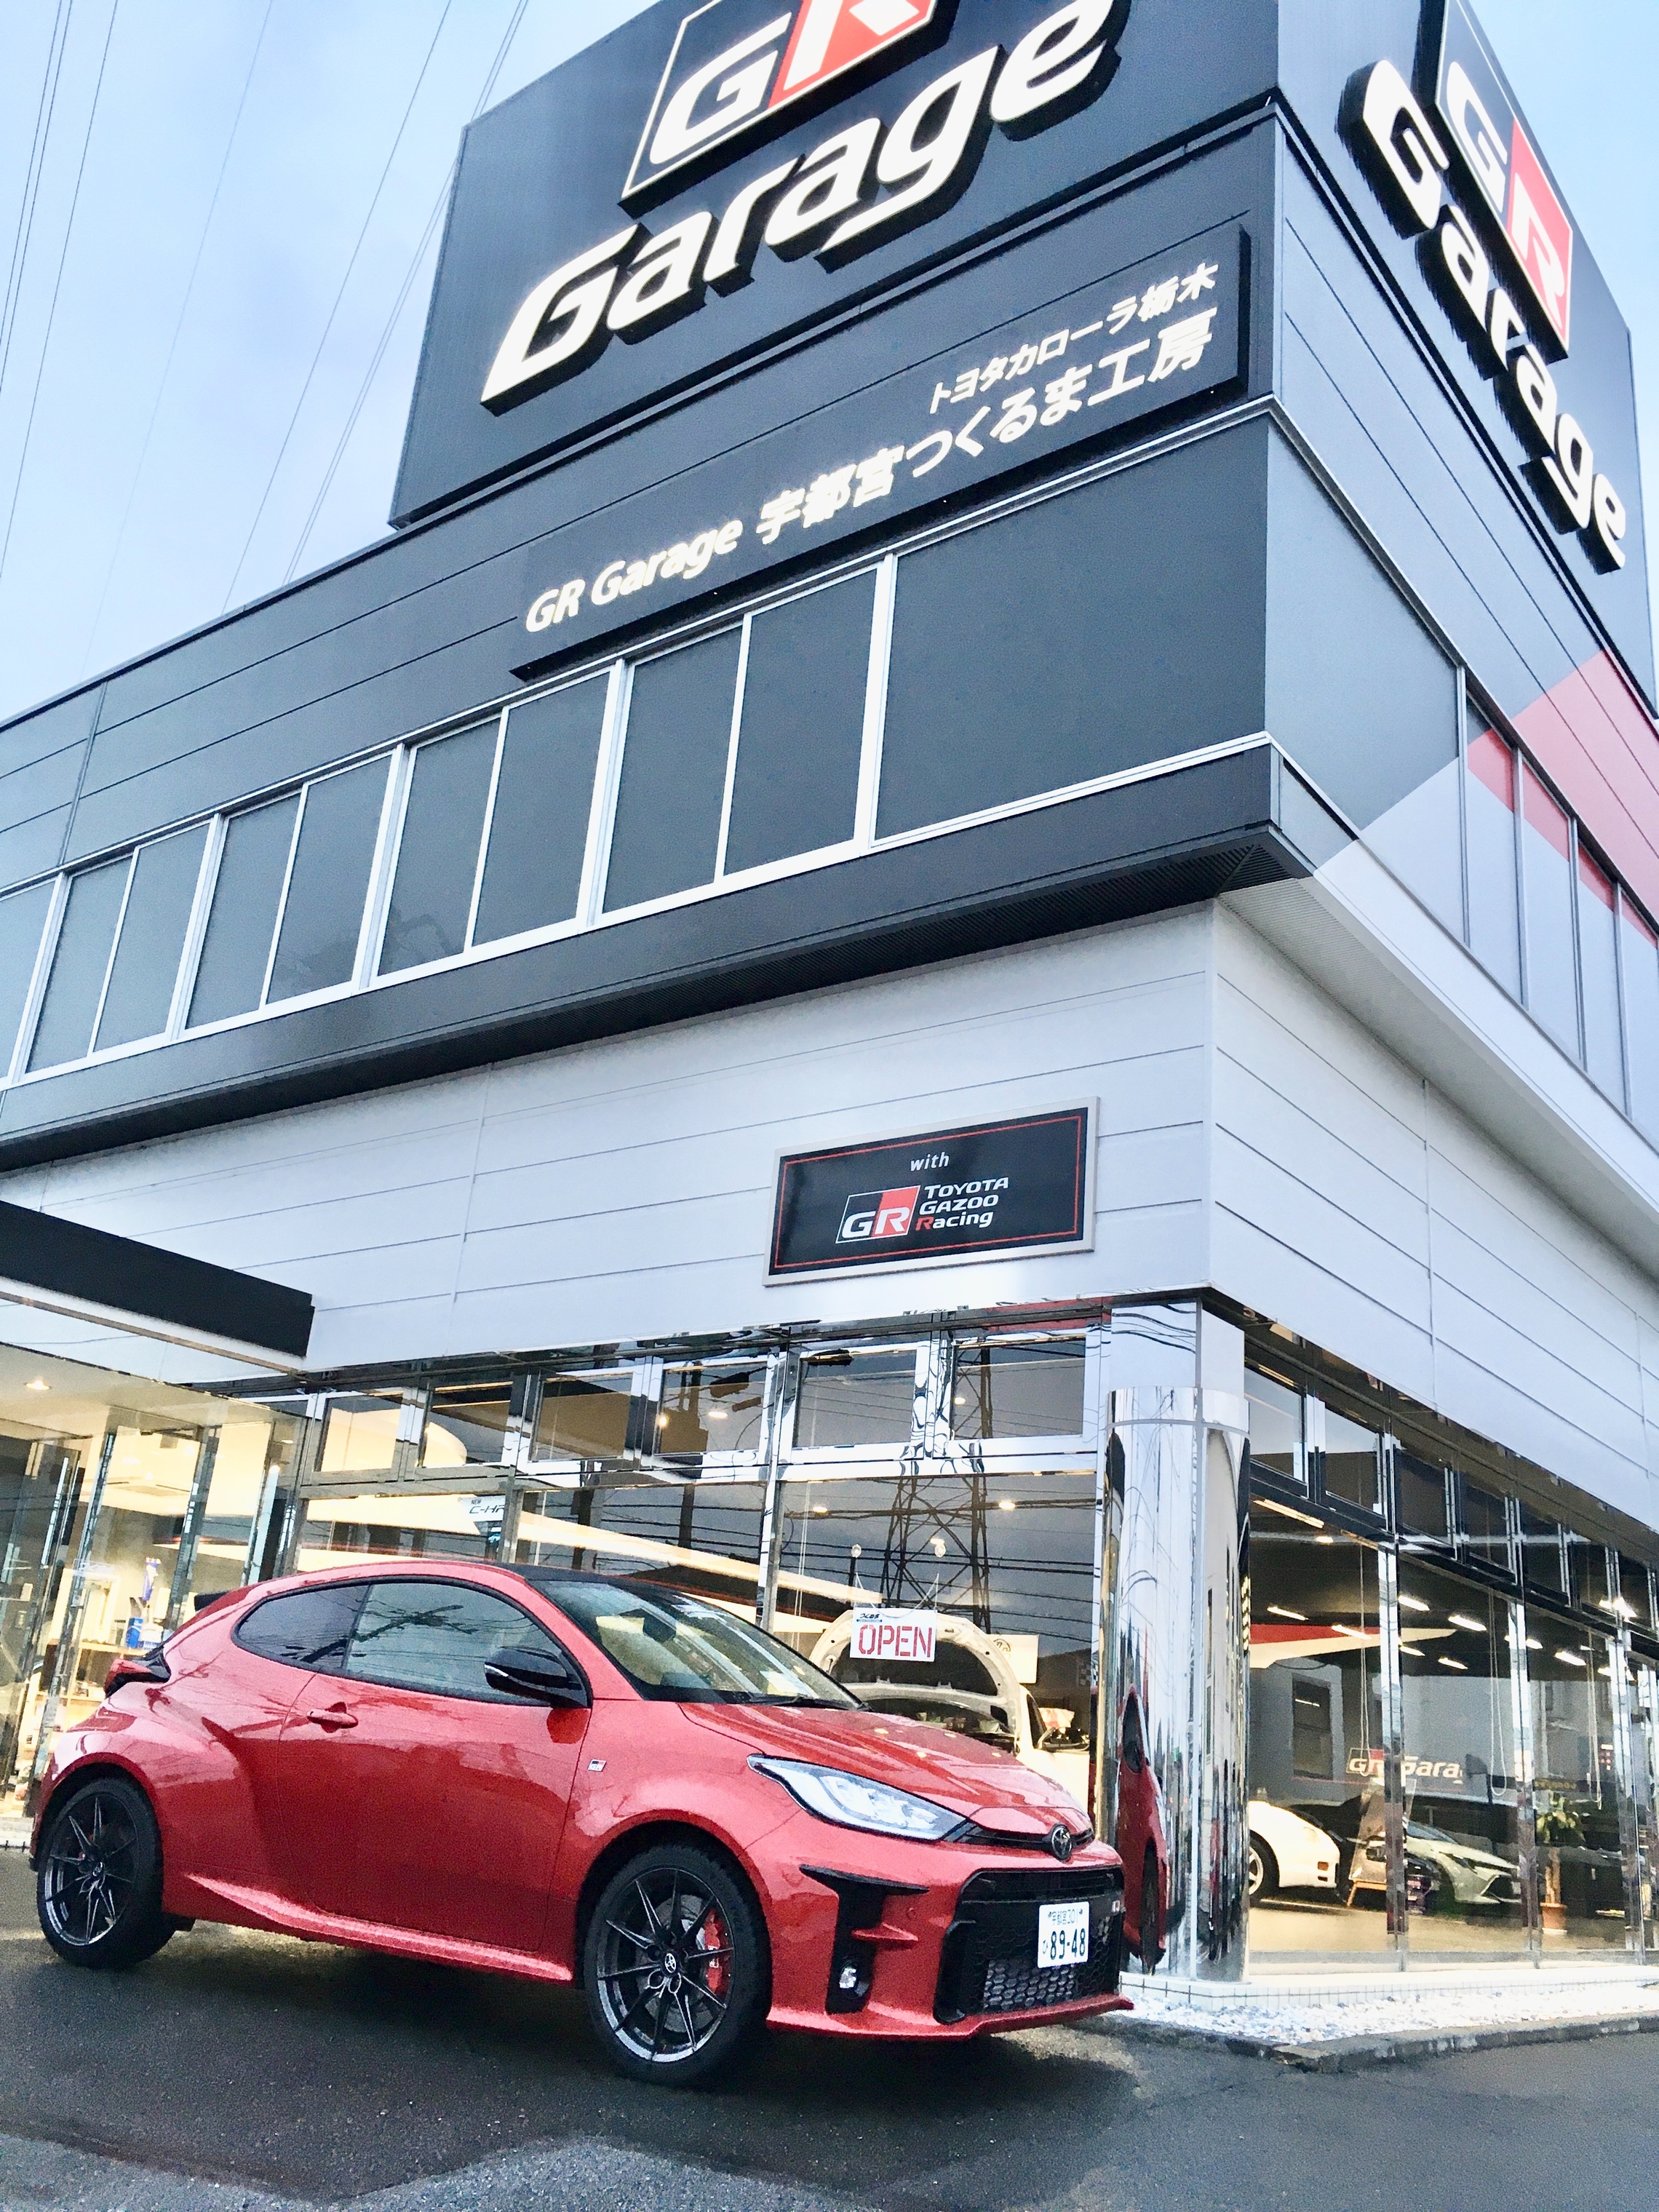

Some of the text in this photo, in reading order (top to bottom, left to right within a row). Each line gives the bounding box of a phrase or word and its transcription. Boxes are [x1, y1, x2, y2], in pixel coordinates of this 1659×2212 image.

[481, 0, 1114, 402] Garage
[1447, 61, 1565, 330] GR
[1363, 59, 1626, 568] Garage
[929, 262, 1219, 414] トヨタカローラ栃木
[525, 578, 586, 632] GR
[591, 520, 743, 605] Garage
[910, 1152, 950, 1171] with
[923, 1177, 1008, 1199] TOYOTA
[915, 1212, 994, 1231] Racing
[919, 1194, 999, 1216] GAZOO
[841, 1206, 911, 1238] GR
[859, 1624, 933, 1658] OPEN
[1050, 1927, 1086, 1960] 89-48
